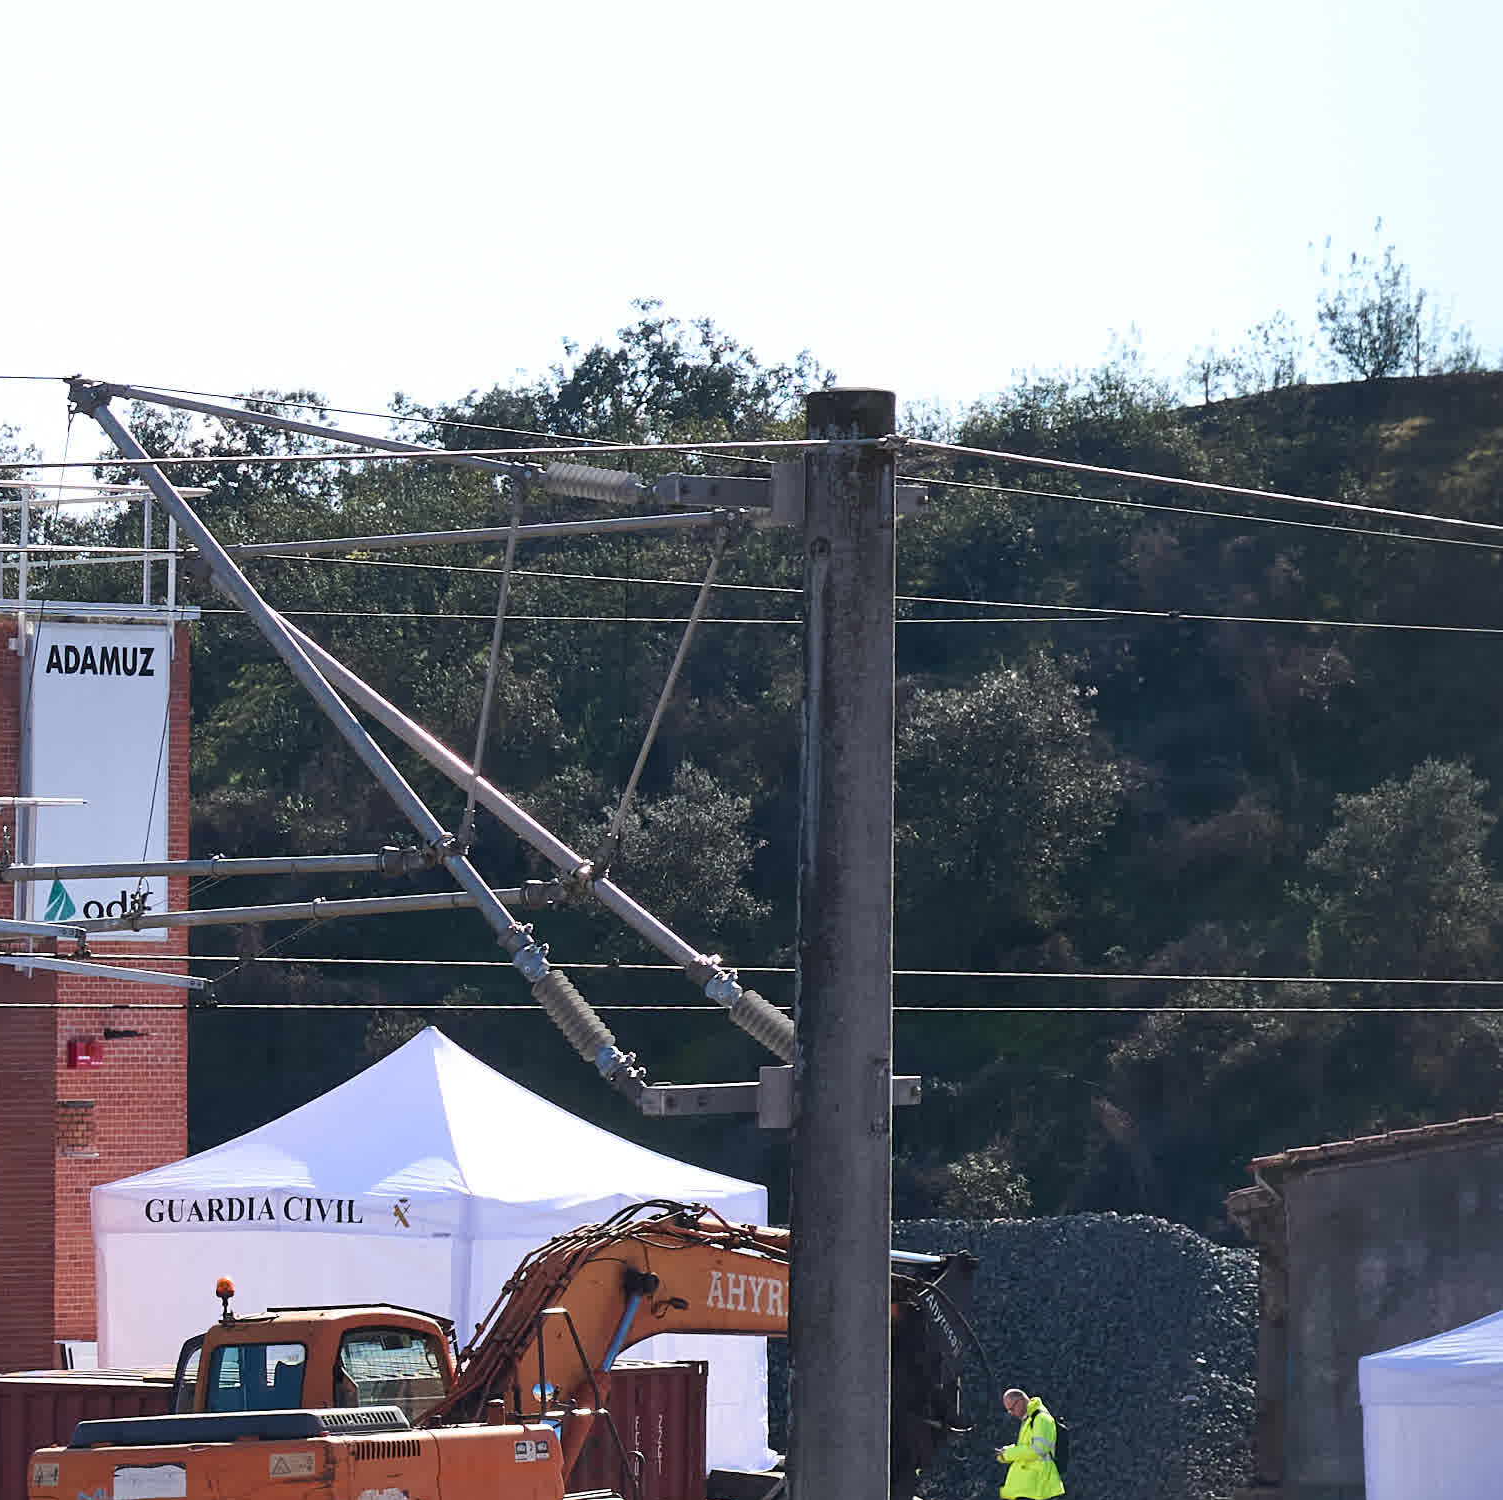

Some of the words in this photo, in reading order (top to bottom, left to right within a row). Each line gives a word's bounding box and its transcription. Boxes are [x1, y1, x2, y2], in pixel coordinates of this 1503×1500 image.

[46, 645, 155, 676] ADAMUZ
[145, 1197, 276, 1223] GUARDIA
[283, 1196, 364, 1223] CIVIL
[707, 1271, 789, 1317] AHYR
